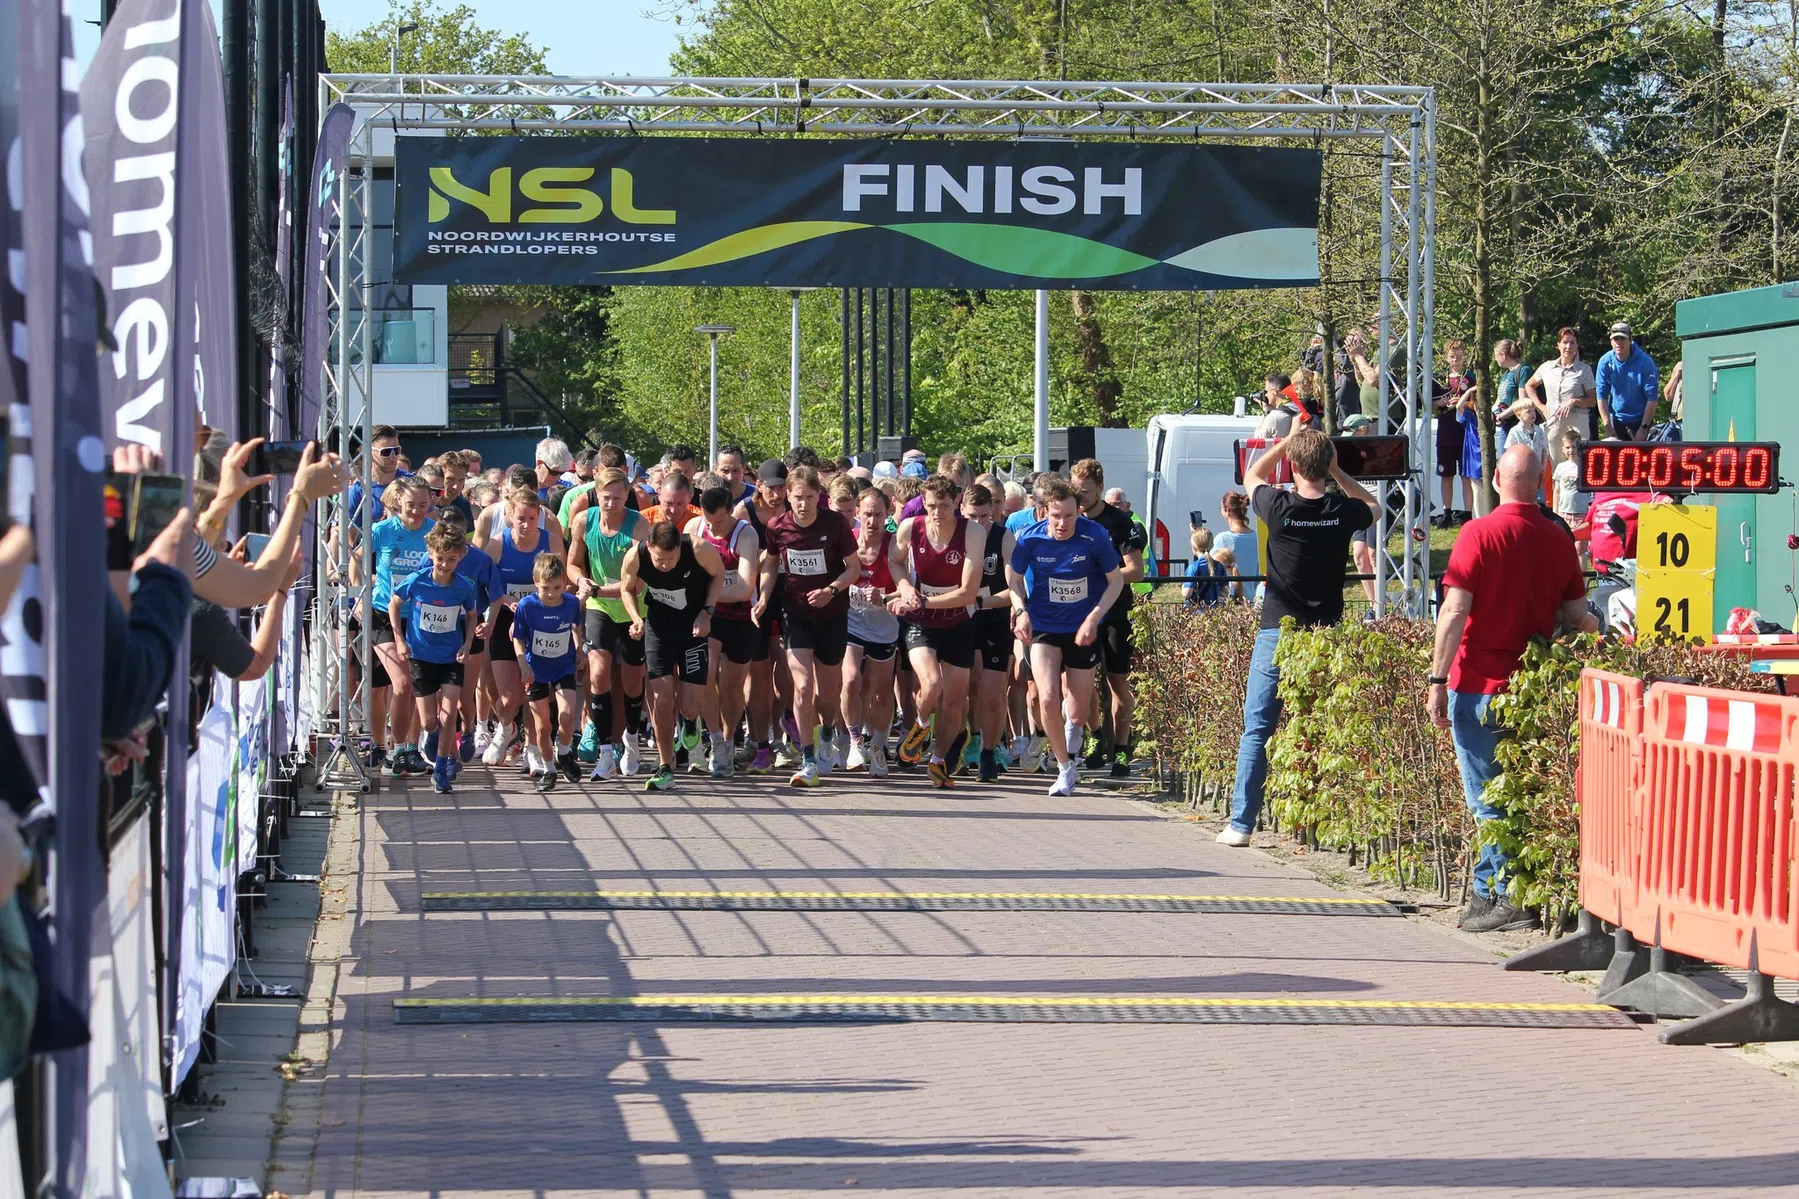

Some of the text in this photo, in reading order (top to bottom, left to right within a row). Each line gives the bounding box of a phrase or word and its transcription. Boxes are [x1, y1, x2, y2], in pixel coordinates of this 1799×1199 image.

[428, 166, 677, 225] NSL
[842, 163, 1143, 216] FINISH
[427, 231, 677, 243] NOORDWIJKERHOUTSE
[427, 244, 599, 255] STRANDLOPERS
[1586, 447, 1769, 487] 00:05:00
[1290, 518, 1340, 527] homewizard
[1656, 531, 1691, 568] 10
[1654, 596, 1690, 633] 21
